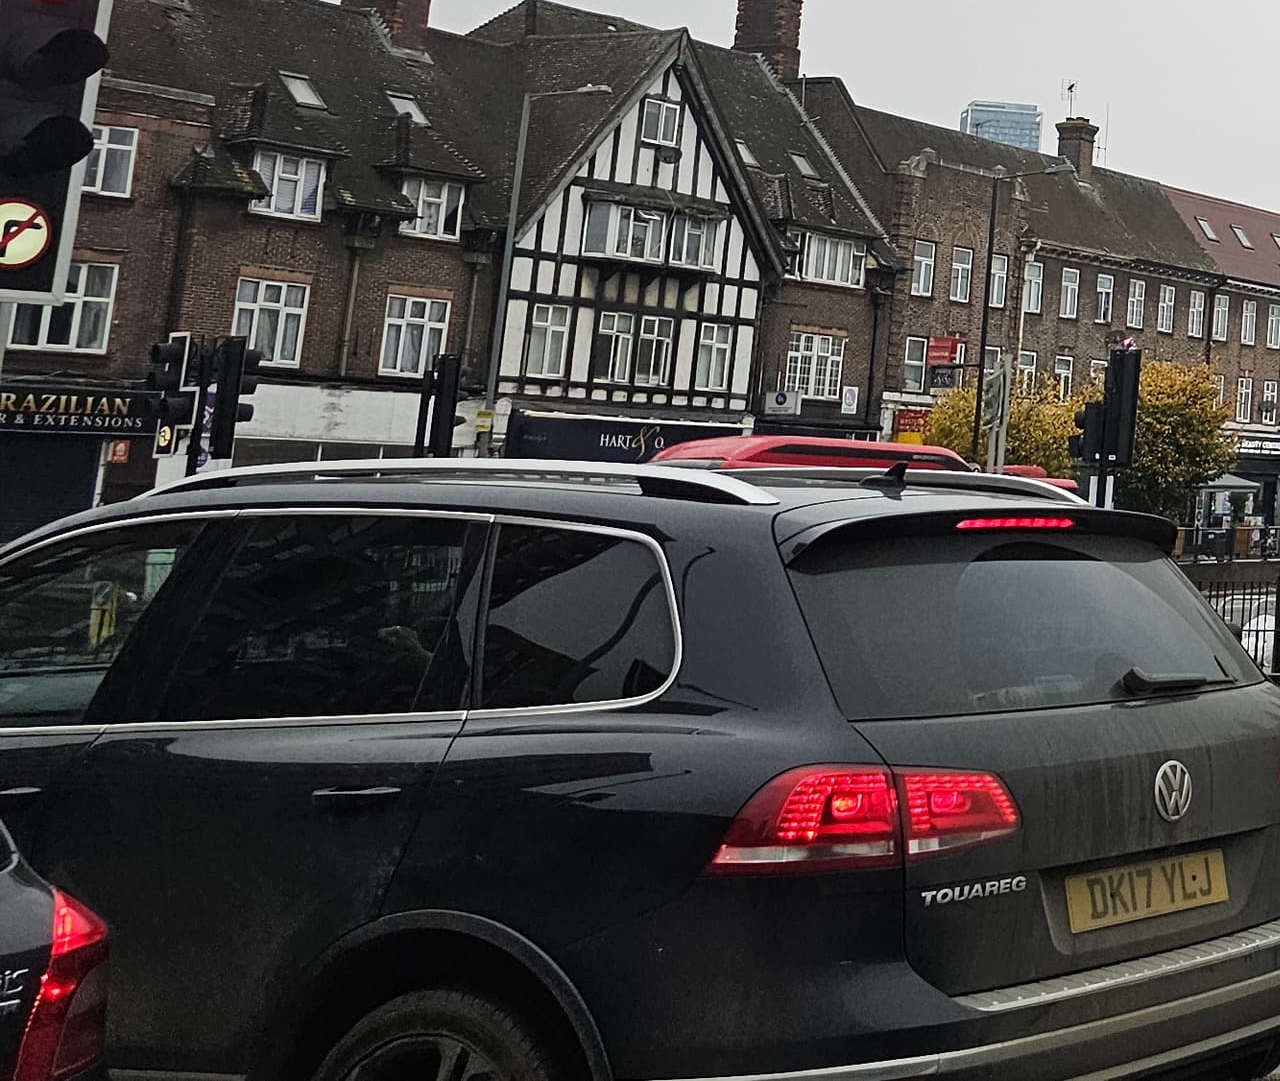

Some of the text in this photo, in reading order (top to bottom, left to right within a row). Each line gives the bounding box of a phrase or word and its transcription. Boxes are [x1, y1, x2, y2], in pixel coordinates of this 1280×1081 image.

[14, 413, 24, 424] &
[33, 414, 143, 428] EXTENSIONS
[600, 434, 632, 449] HART
[921, 876, 1027, 907] TOUAREG
[1086, 857, 1213, 920] DK17 YLJ
